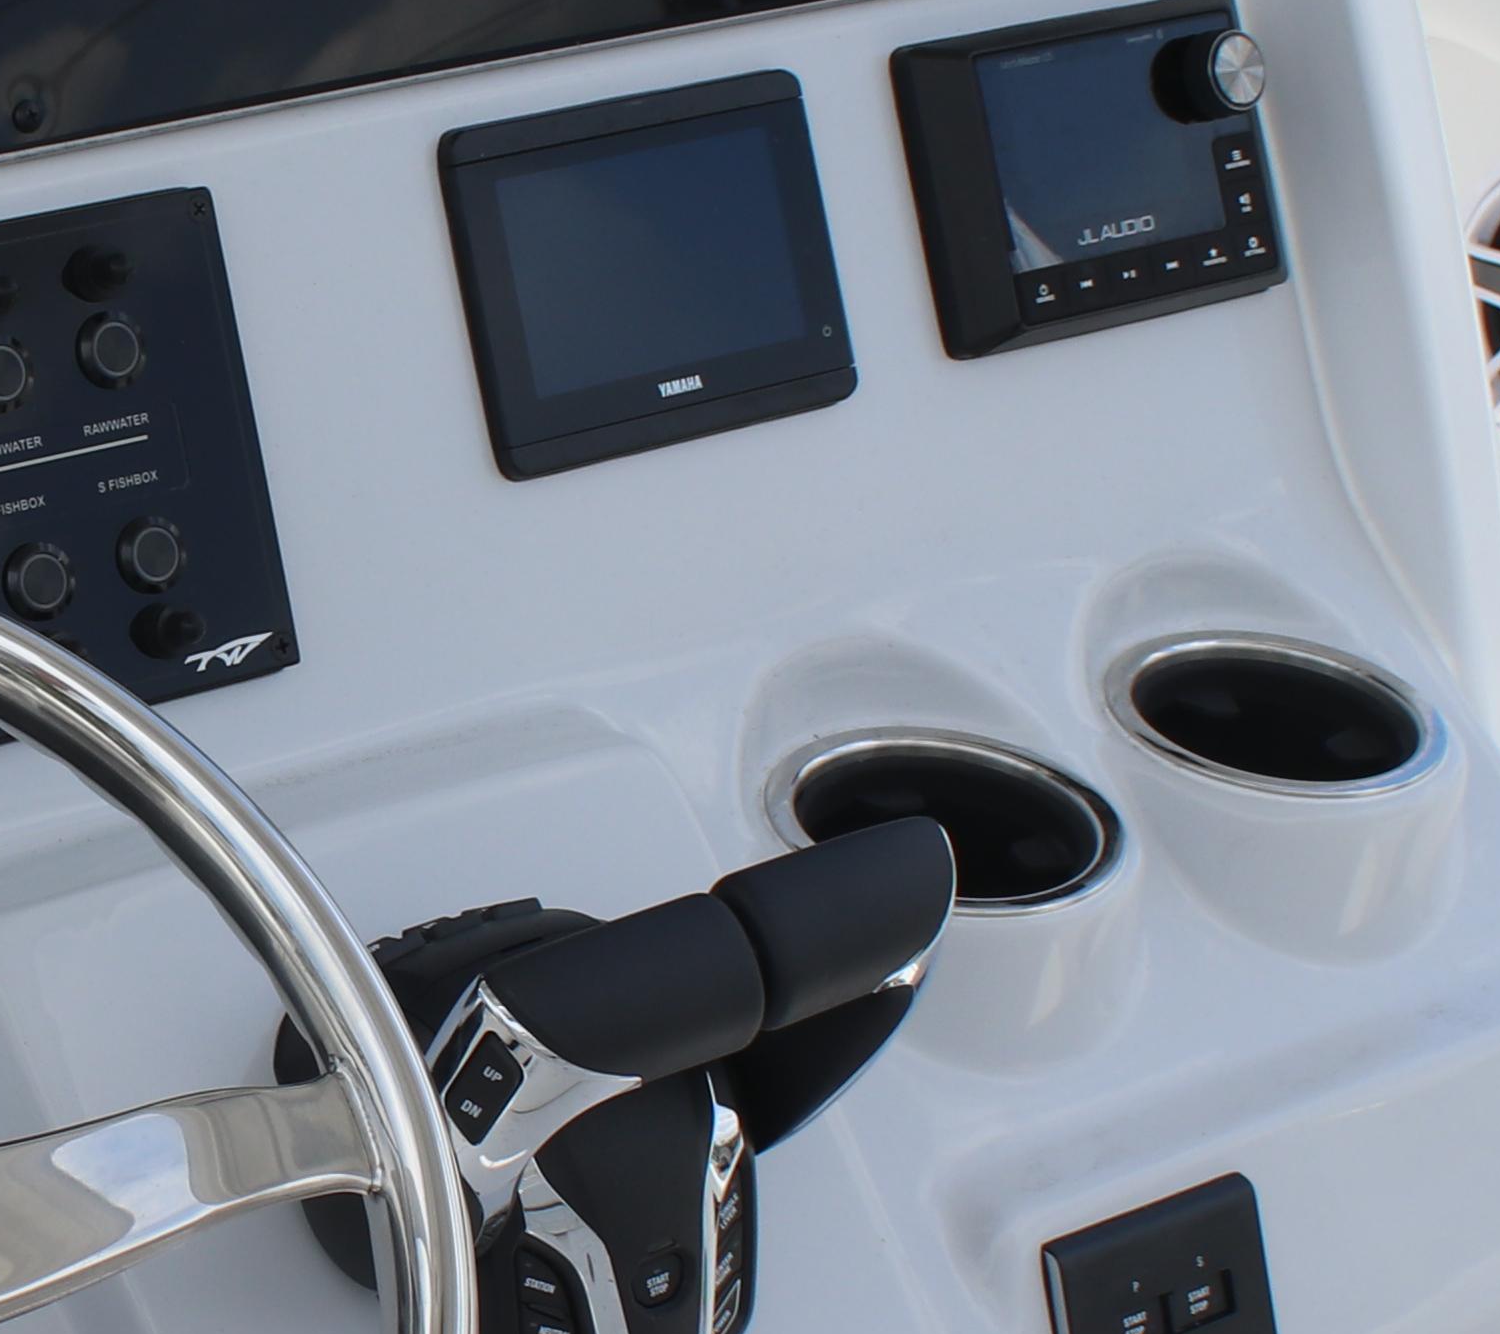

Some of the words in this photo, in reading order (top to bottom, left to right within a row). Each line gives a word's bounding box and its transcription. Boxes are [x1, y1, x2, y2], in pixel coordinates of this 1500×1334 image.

[1077, 229, 1099, 246] JL
[1099, 215, 1156, 241] AUDIO
[657, 374, 704, 398] YAMAHA
[83, 412, 150, 437] RAWWATER
[96, 481, 106, 495] S
[107, 469, 159, 493] FISHBOX
[482, 1066, 503, 1083] UP
[460, 1099, 482, 1119] DN
[647, 1272, 670, 1288] START
[649, 1283, 669, 1297] STOP
[1123, 1310, 1147, 1328] START
